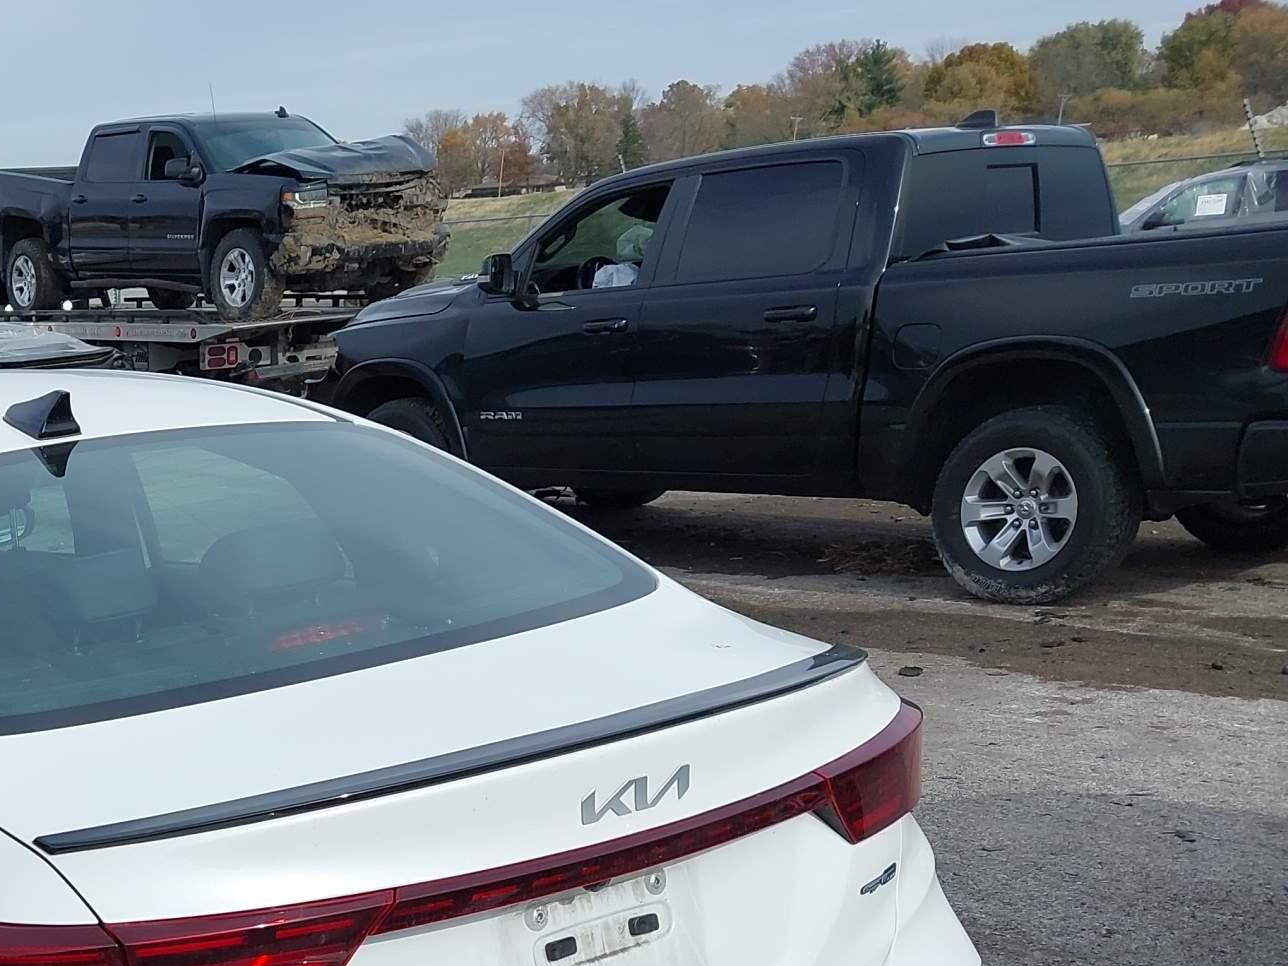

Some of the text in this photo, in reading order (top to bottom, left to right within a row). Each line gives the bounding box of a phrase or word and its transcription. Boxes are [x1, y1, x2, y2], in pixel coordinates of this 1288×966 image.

[1129, 278, 1264, 298] SPORT
[479, 411, 522, 420] RAM
[580, 763, 691, 826] KIA
